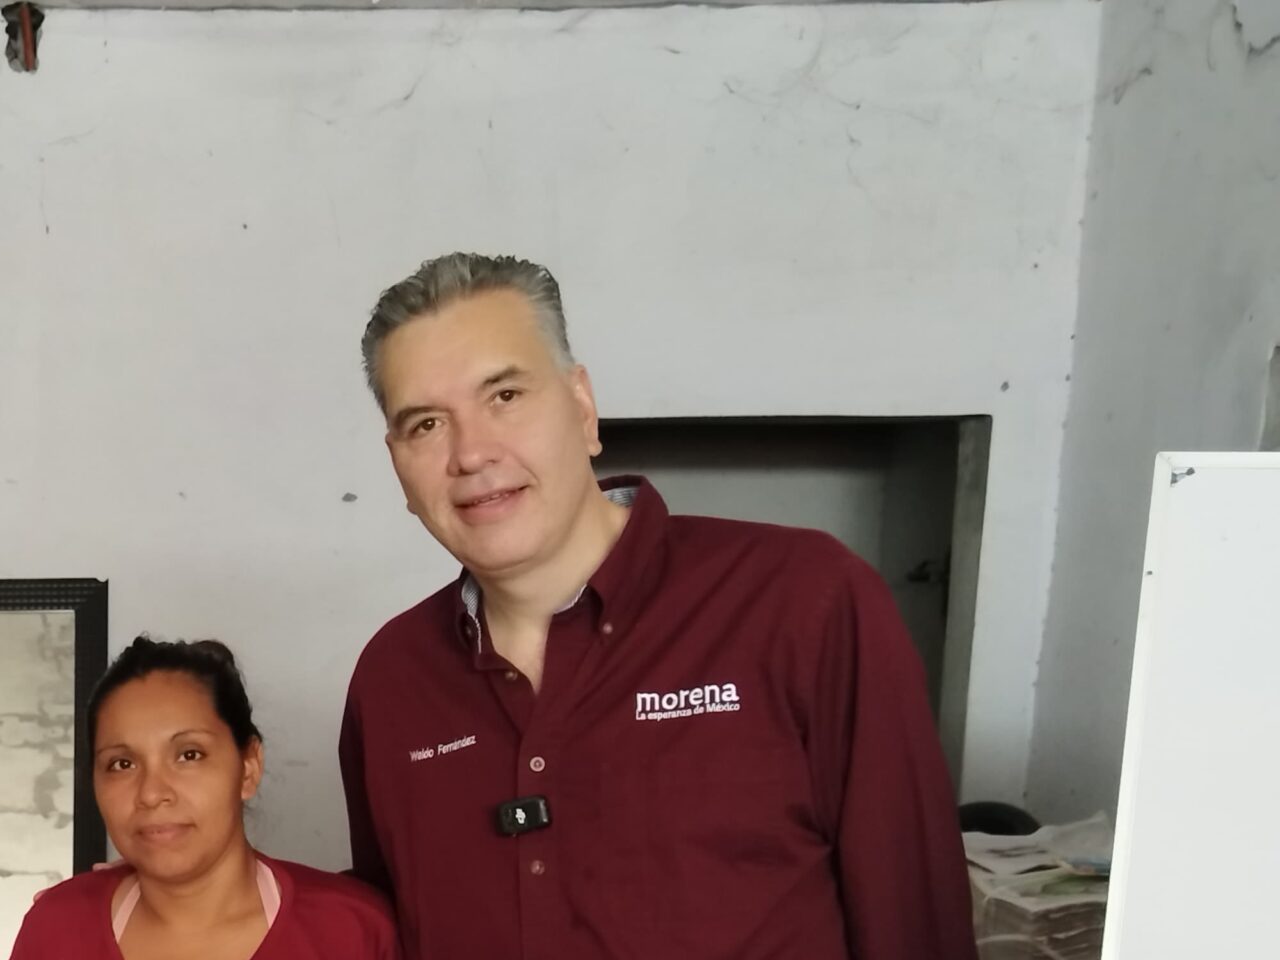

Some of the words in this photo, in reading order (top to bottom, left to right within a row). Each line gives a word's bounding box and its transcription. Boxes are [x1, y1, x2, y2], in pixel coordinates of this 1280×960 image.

[636, 683, 740, 712] morena
[648, 709, 692, 722] esperanza
[693, 705, 705, 715] de
